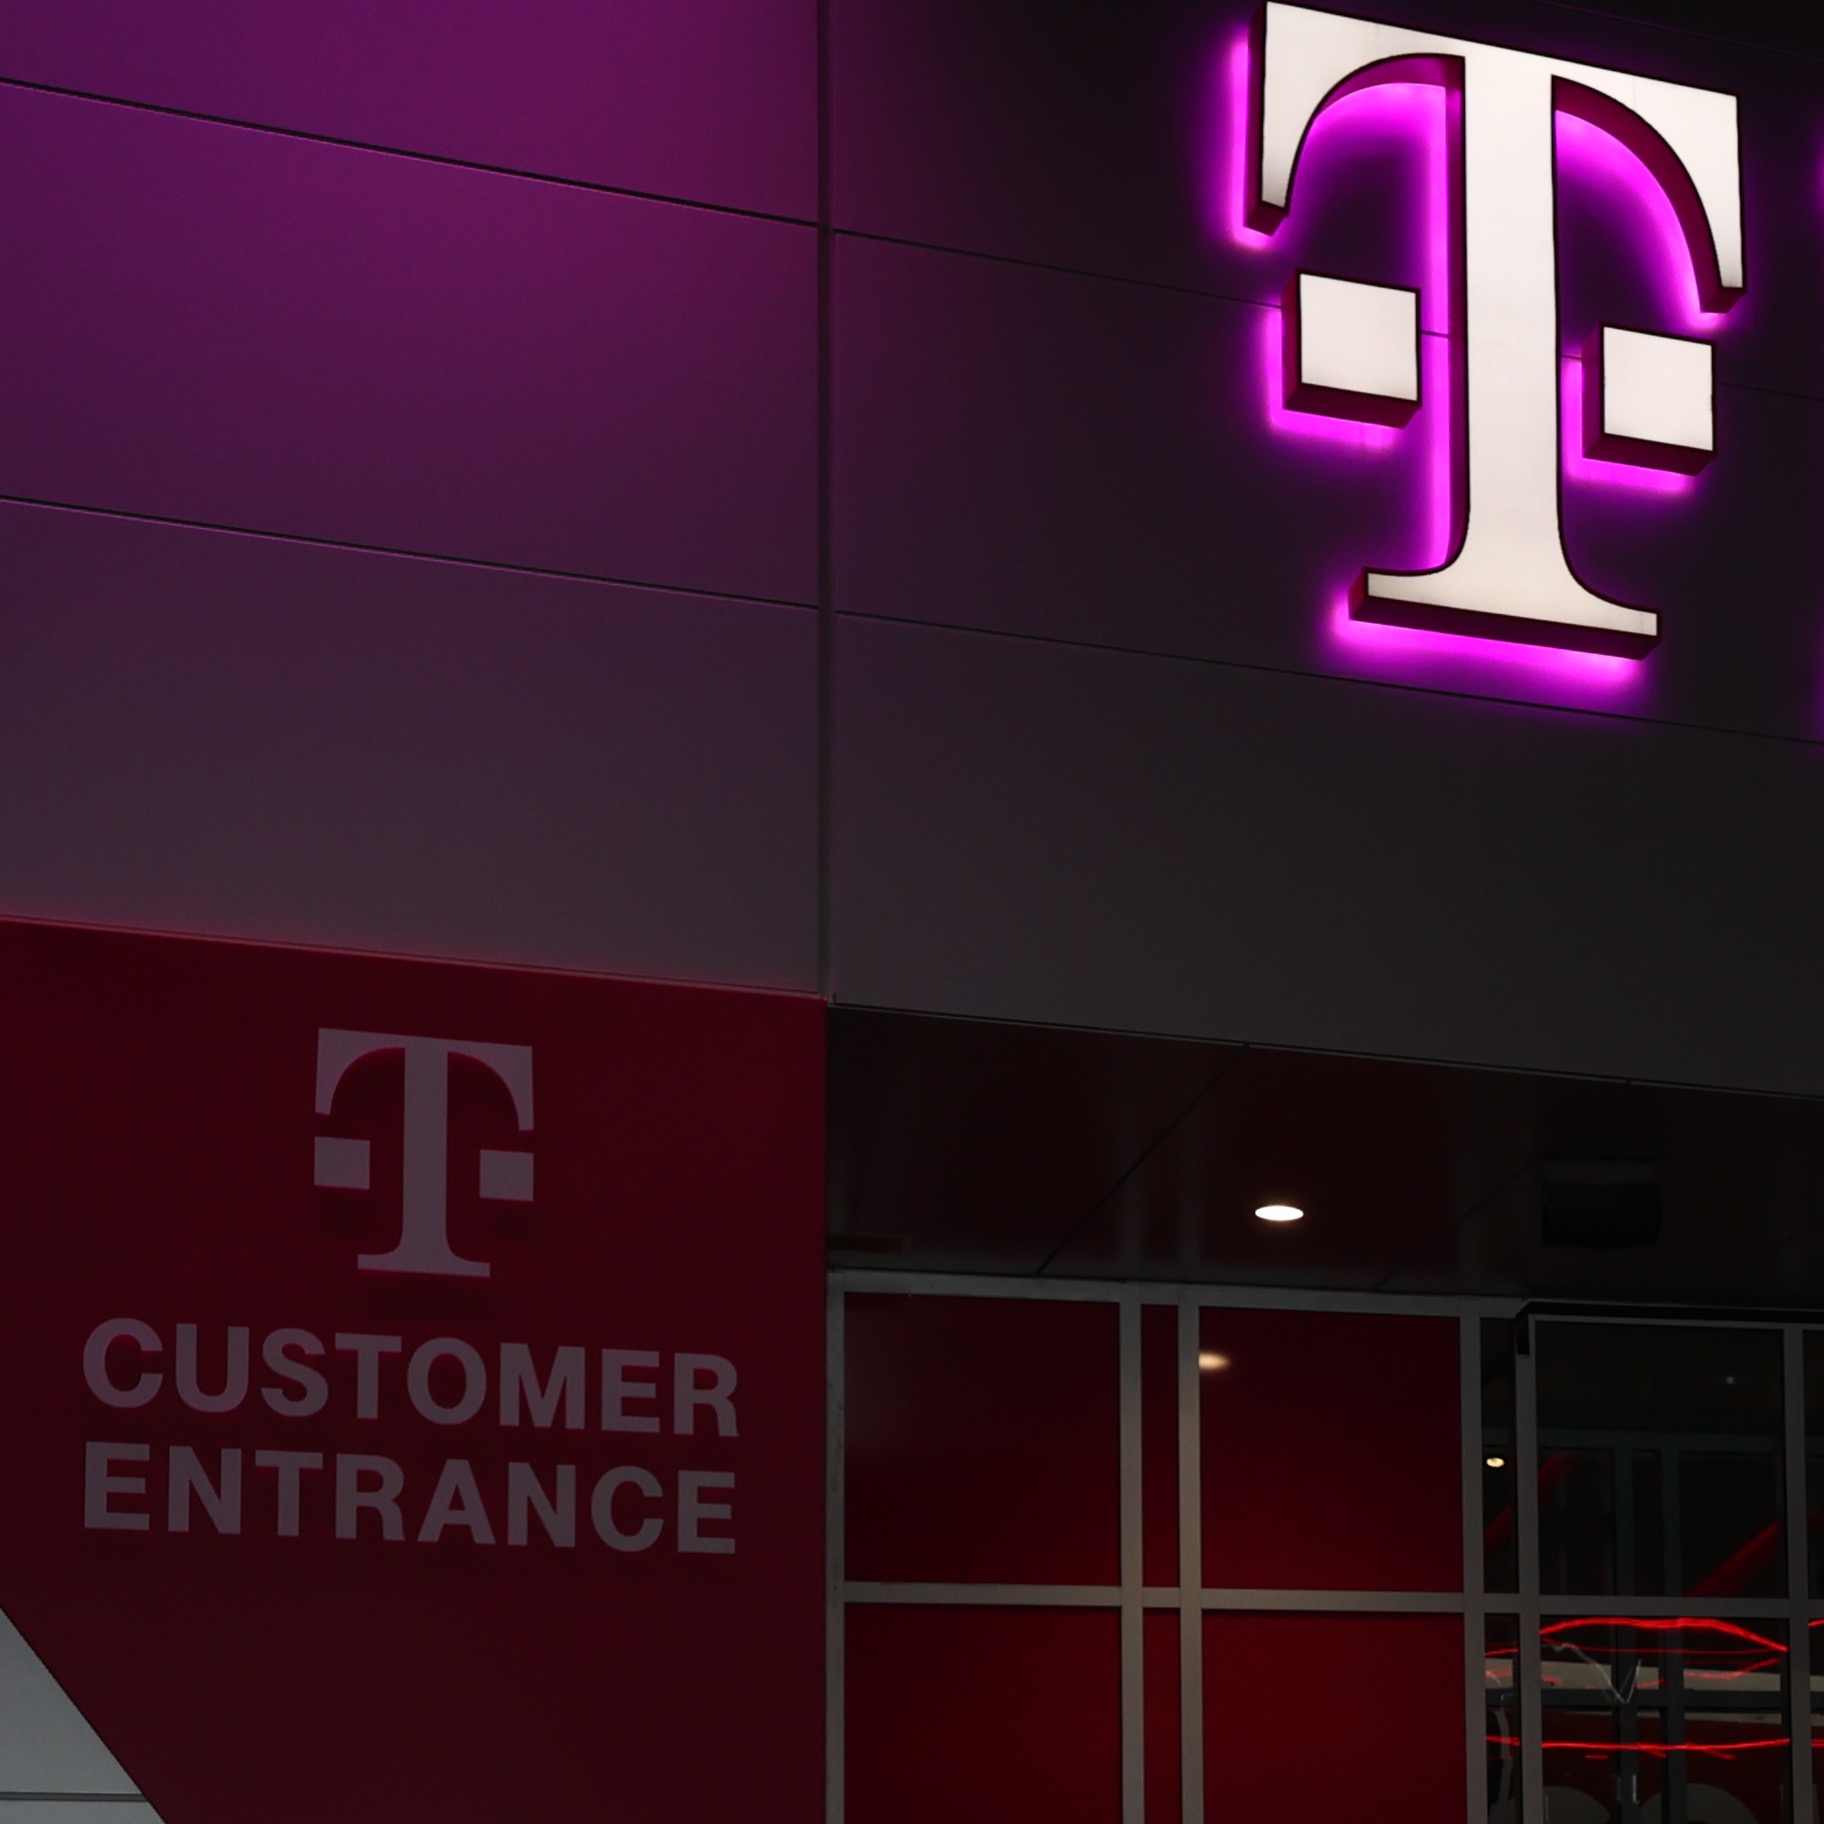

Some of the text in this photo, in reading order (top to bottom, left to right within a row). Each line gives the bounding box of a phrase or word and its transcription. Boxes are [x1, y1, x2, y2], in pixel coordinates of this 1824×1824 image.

[1252, 1, 1744, 650] T
[314, 1027, 535, 1279] T
[83, 1318, 740, 1438] CUSTOMER
[84, 1441, 737, 1555] ENTRANCE
